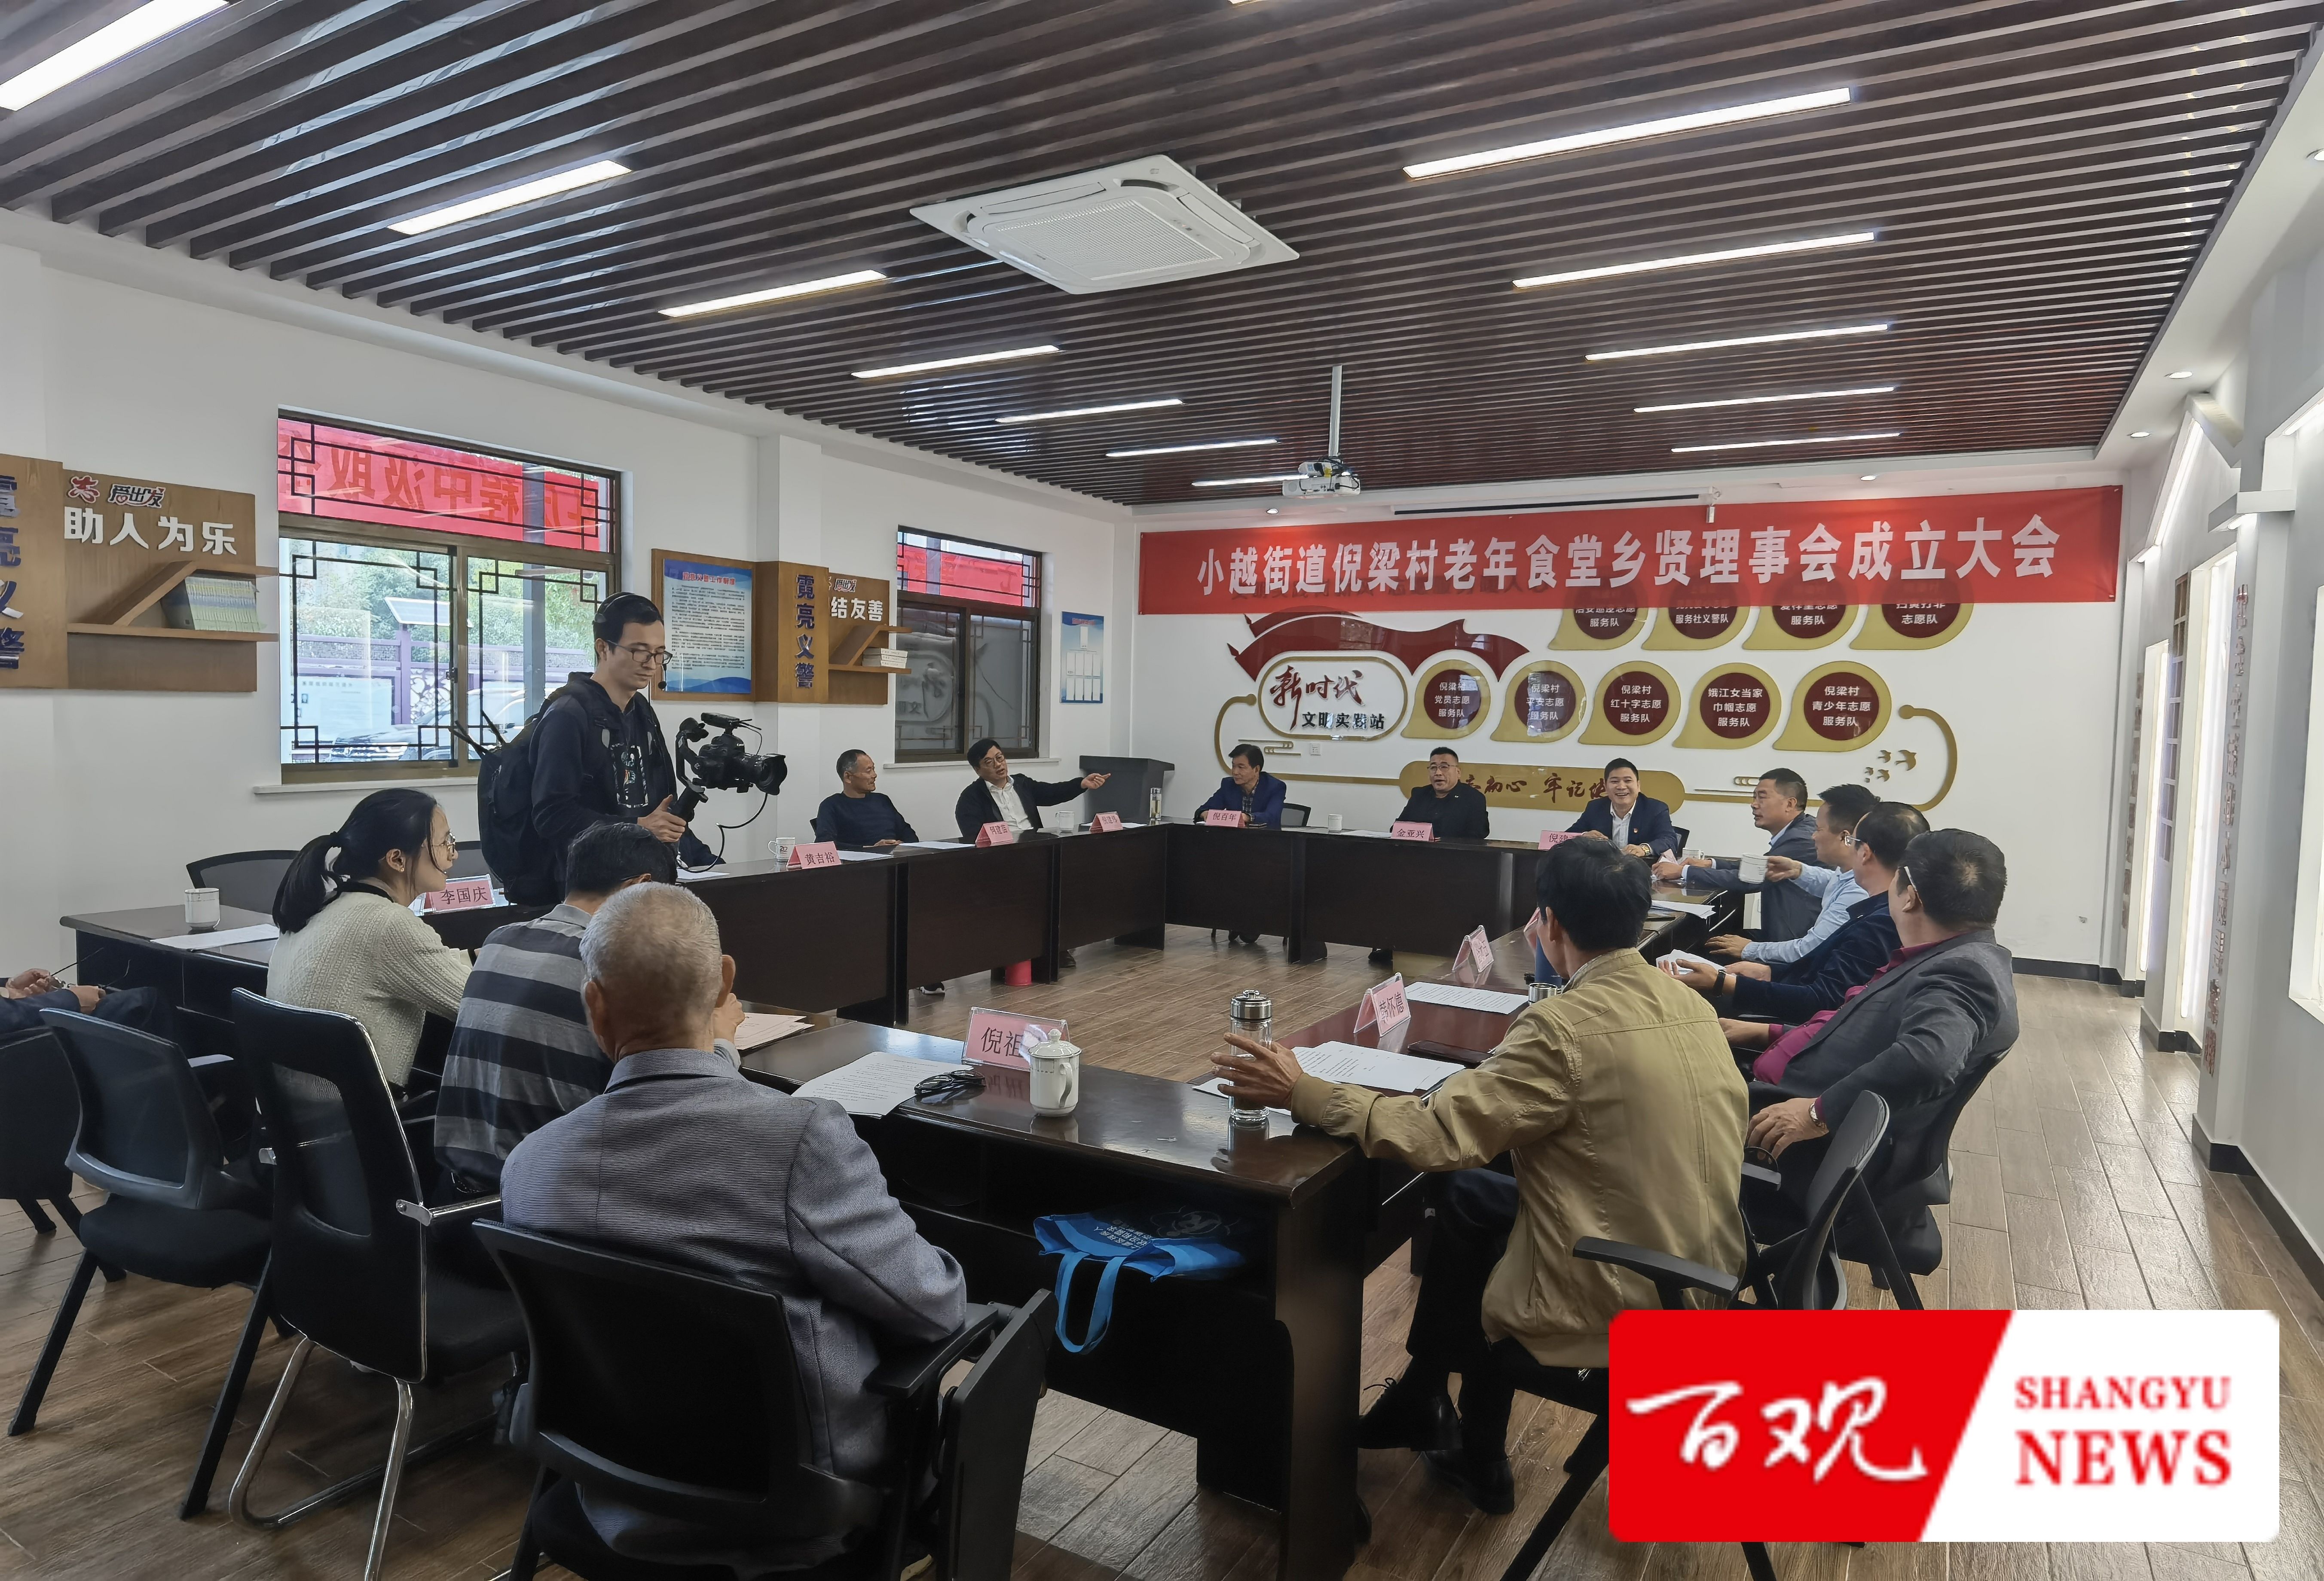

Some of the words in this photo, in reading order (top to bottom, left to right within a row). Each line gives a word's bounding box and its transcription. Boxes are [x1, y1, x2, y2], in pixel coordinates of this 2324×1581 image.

[110, 484, 165, 508] 爱出发
[64, 506, 237, 555] 助人为乐
[1197, 514, 2061, 595] 小越街道倪梁村老年食堂乡贤理事会成立大会
[1590, 618, 1619, 627] 服务队
[1675, 613, 1729, 624] 服务社义警队
[1791, 615, 1825, 626] 服务队
[1901, 614, 1939, 624] 志愿队
[1439, 682, 1466, 691] 倪梁村
[1531, 684, 1560, 693] 倪梁村
[1621, 685, 1652, 695] 倪梁村
[1824, 686, 1860, 696] 倪梁村
[1269, 665, 1365, 730] 新时代
[1708, 688, 1763, 698] 娥江女当家
[1434, 695, 1470, 704] 党员志愿
[1526, 697, 1564, 707] 平安志愿
[1610, 699, 1662, 709] 红十字志愿
[1713, 702, 1757, 712] 巾帼志愿
[1812, 701, 1871, 711] 青少年志愿
[1438, 708, 1465, 717] 服务队
[1530, 711, 1559, 720] 服务队
[1302, 711, 1385, 729] 文明实践站
[1620, 713, 1650, 723] 服务队
[1717, 717, 1750, 726] 服务队
[1823, 716, 1858, 726] 服务队
[1213, 812, 1236, 821] 倪百年
[1396, 829, 1425, 838] 金亚兴
[1549, 833, 1575, 843] 倪建
[805, 852, 835, 865] 黄吉裕
[440, 886, 488, 904] 李国庆
